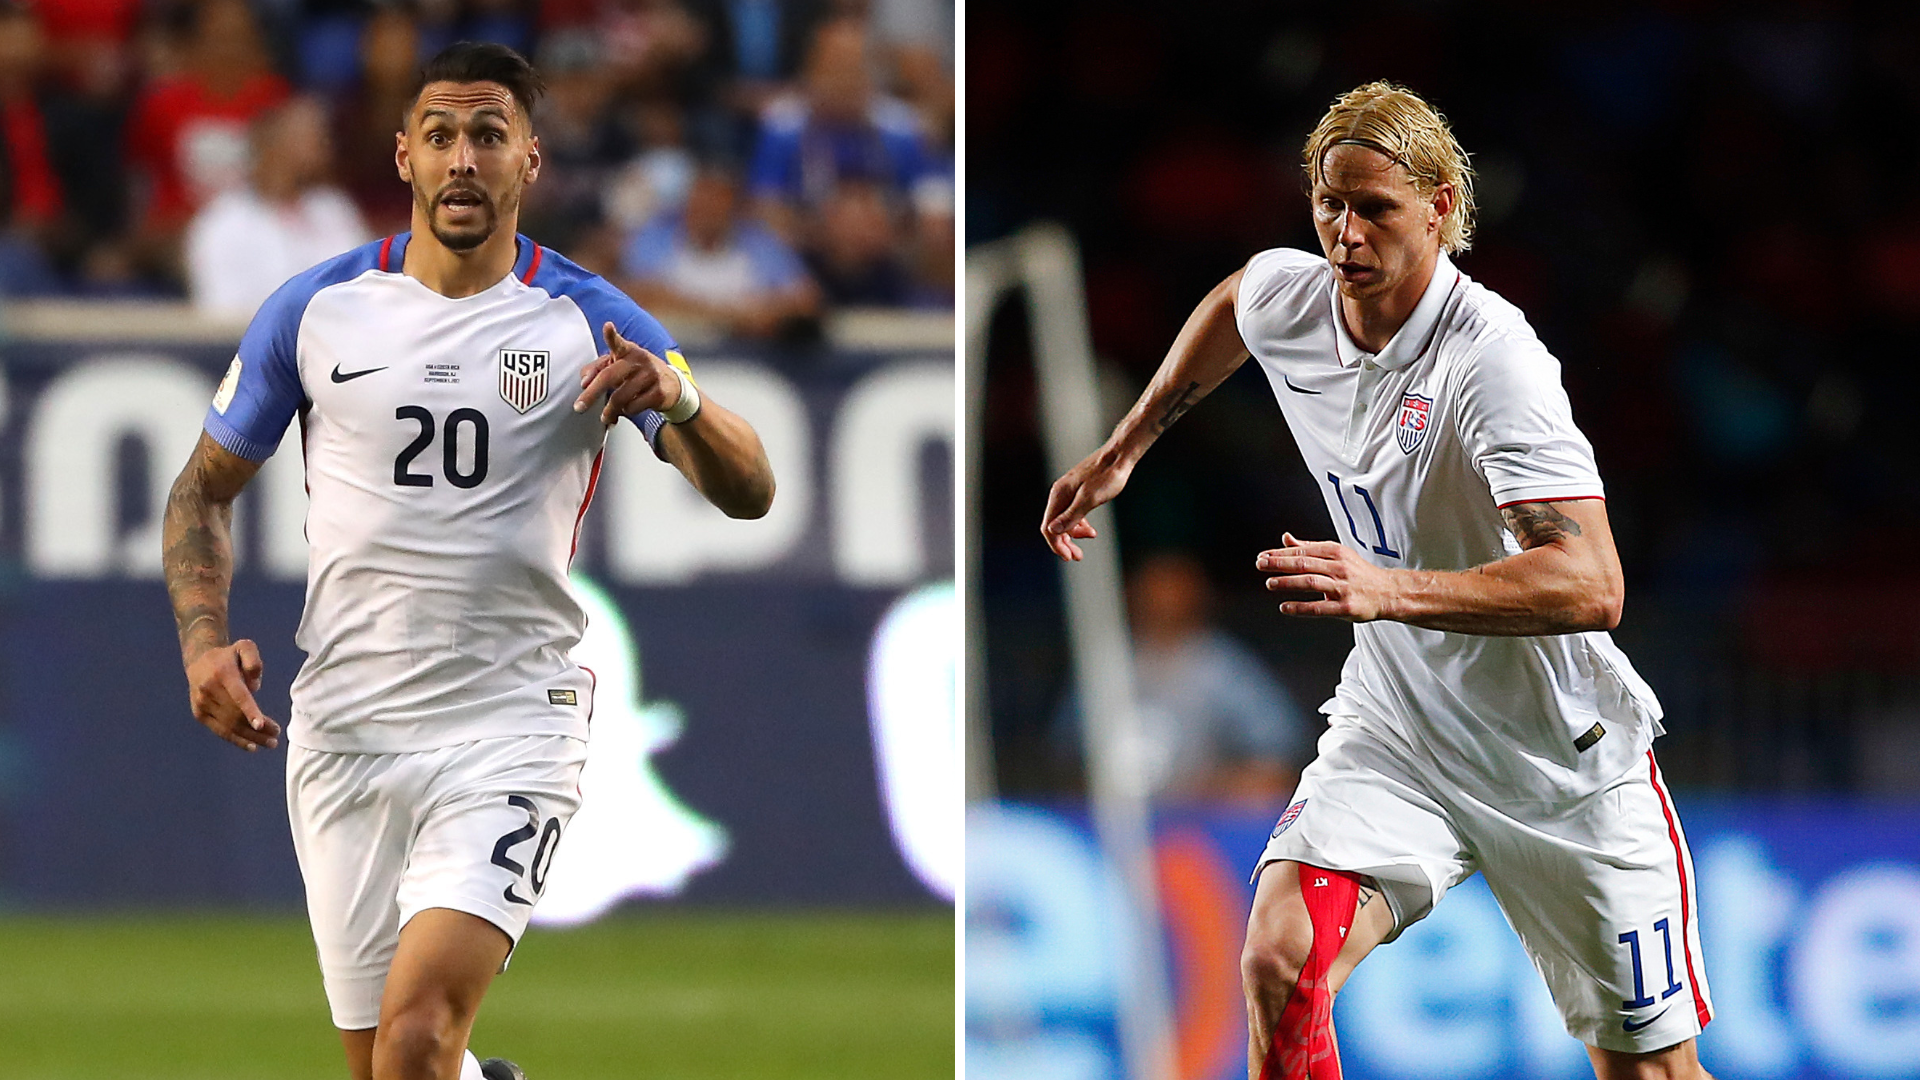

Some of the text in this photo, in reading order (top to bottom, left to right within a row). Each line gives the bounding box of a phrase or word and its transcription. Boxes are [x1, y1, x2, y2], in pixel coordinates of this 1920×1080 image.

[504, 353, 545, 376] USA
[394, 405, 489, 489] 20
[1327, 471, 1401, 559] 11
[490, 795, 561, 895] 20
[1618, 916, 1683, 1010] 11
